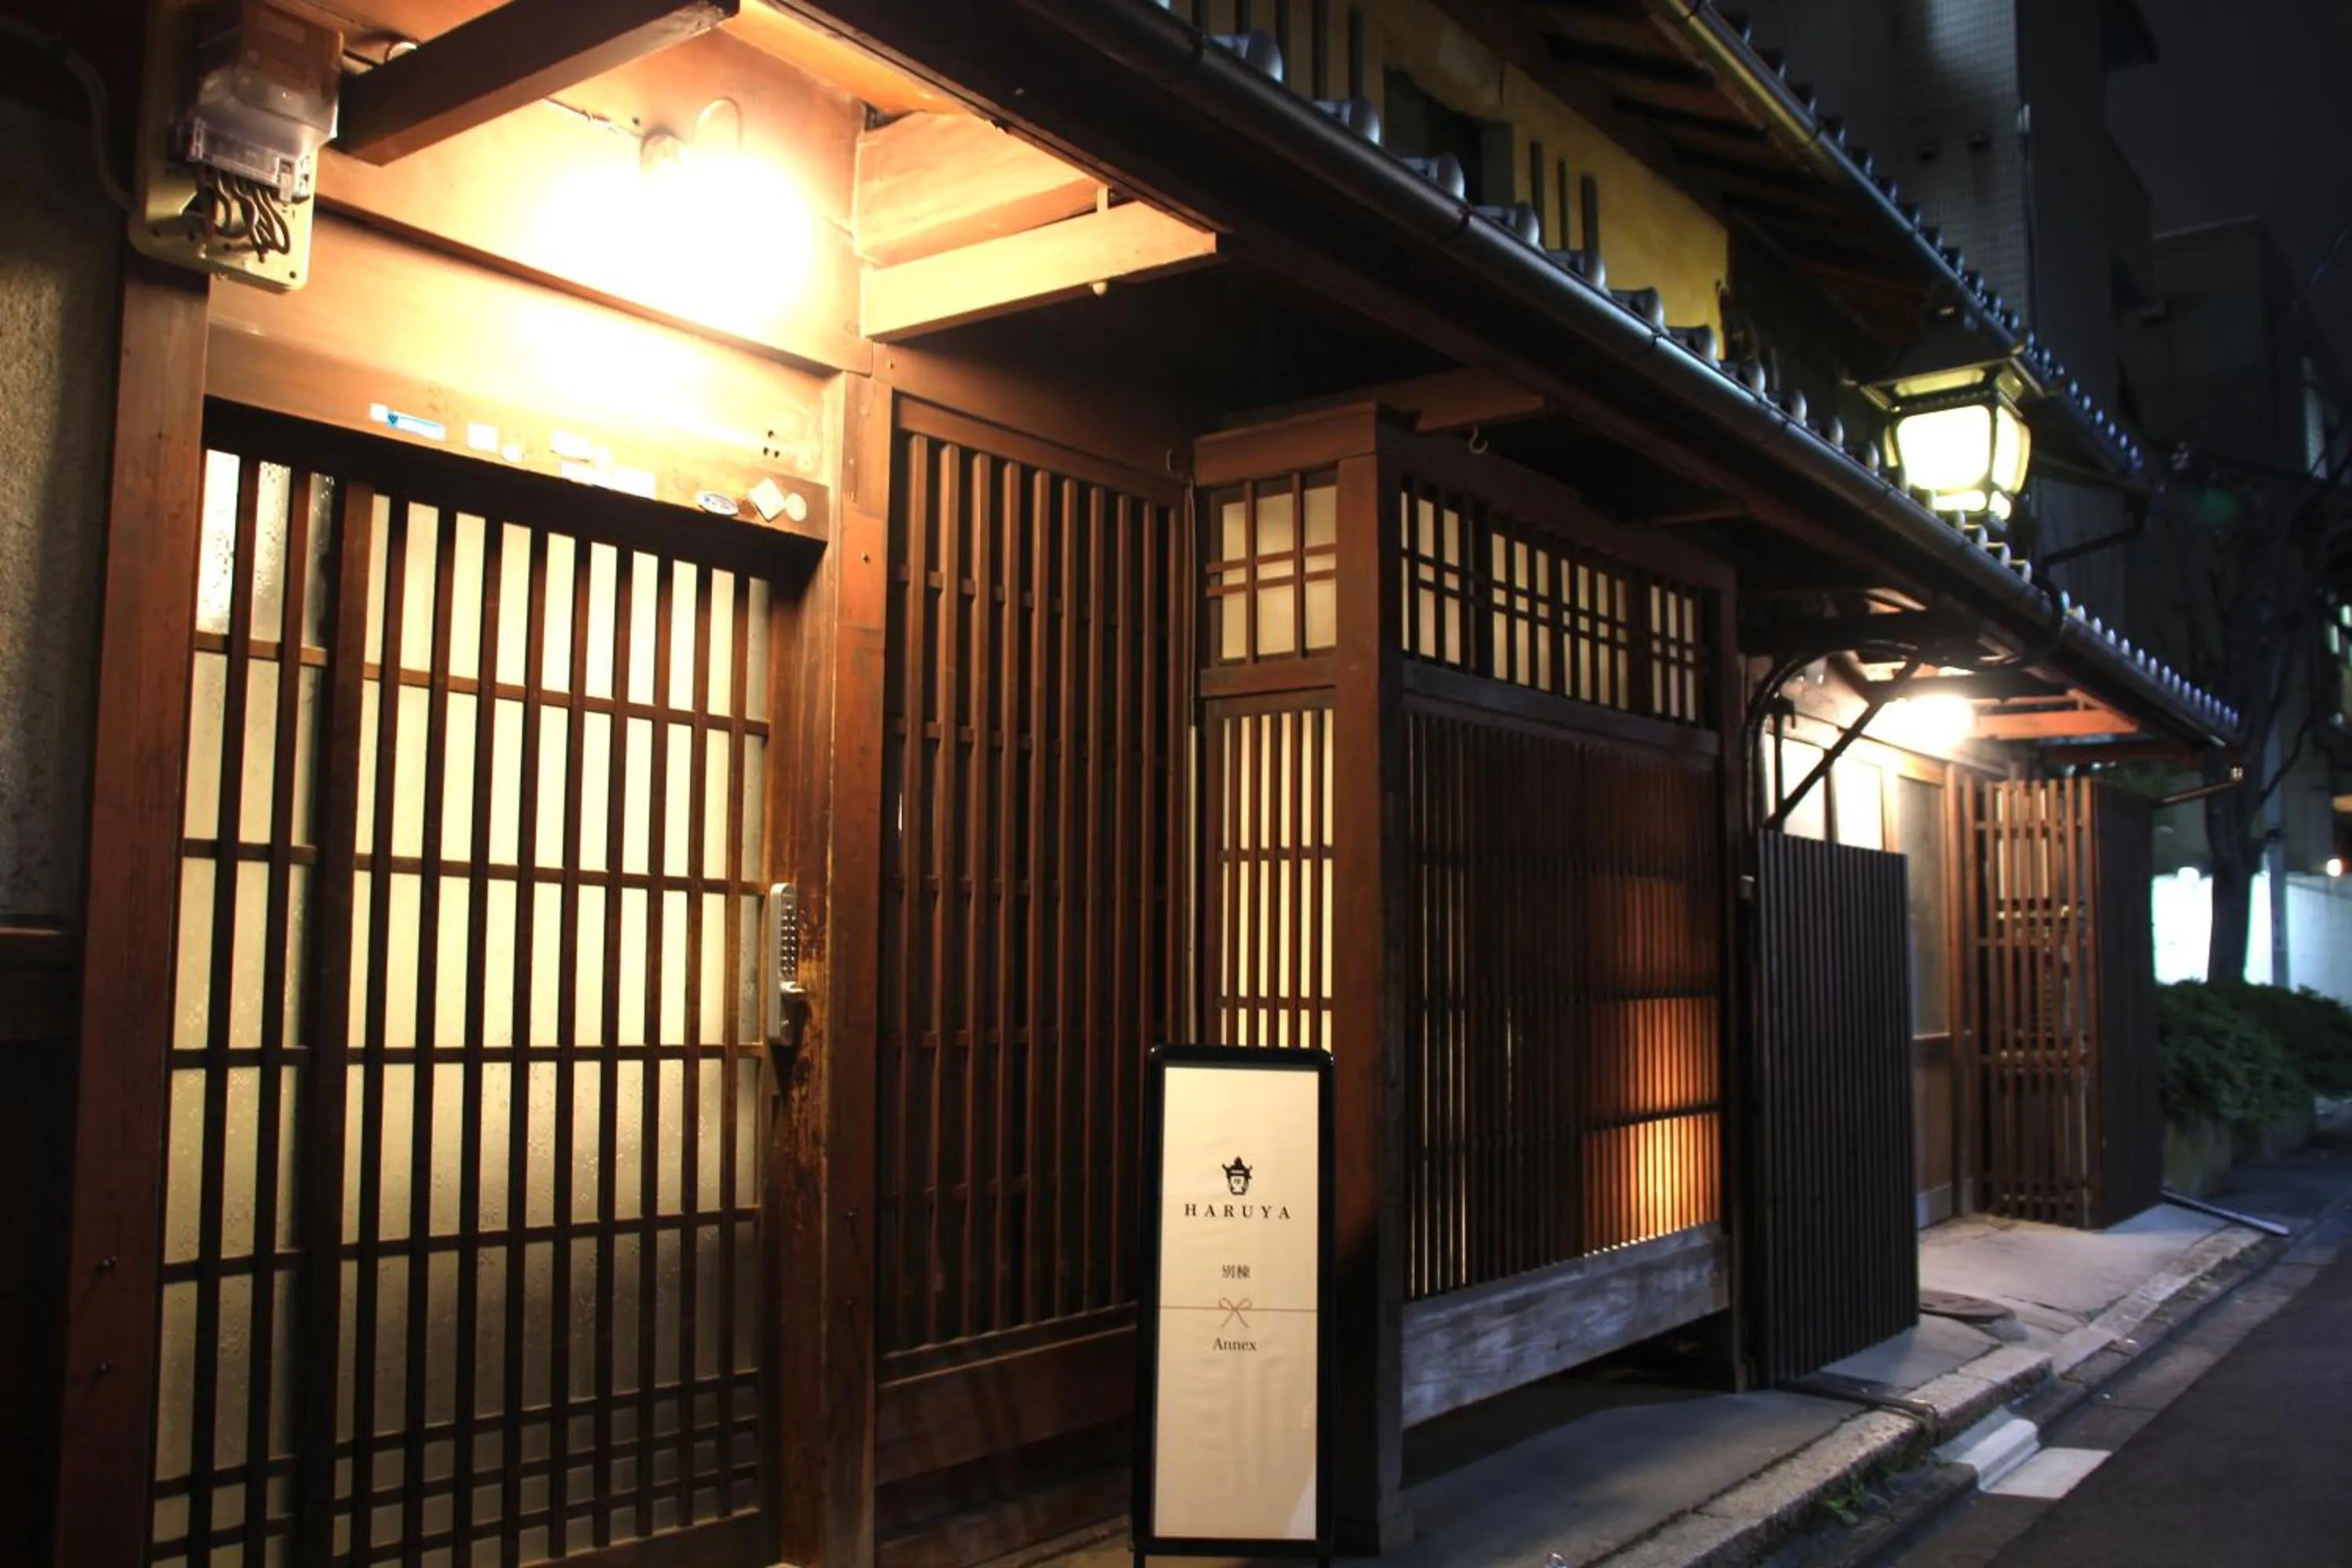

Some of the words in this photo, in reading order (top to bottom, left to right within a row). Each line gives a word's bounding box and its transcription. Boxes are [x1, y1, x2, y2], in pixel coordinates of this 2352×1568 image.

[1184, 1203, 1290, 1219] HARUYA
[1221, 1264, 1250, 1279] 別棟
[1213, 1338, 1257, 1351] Annex
